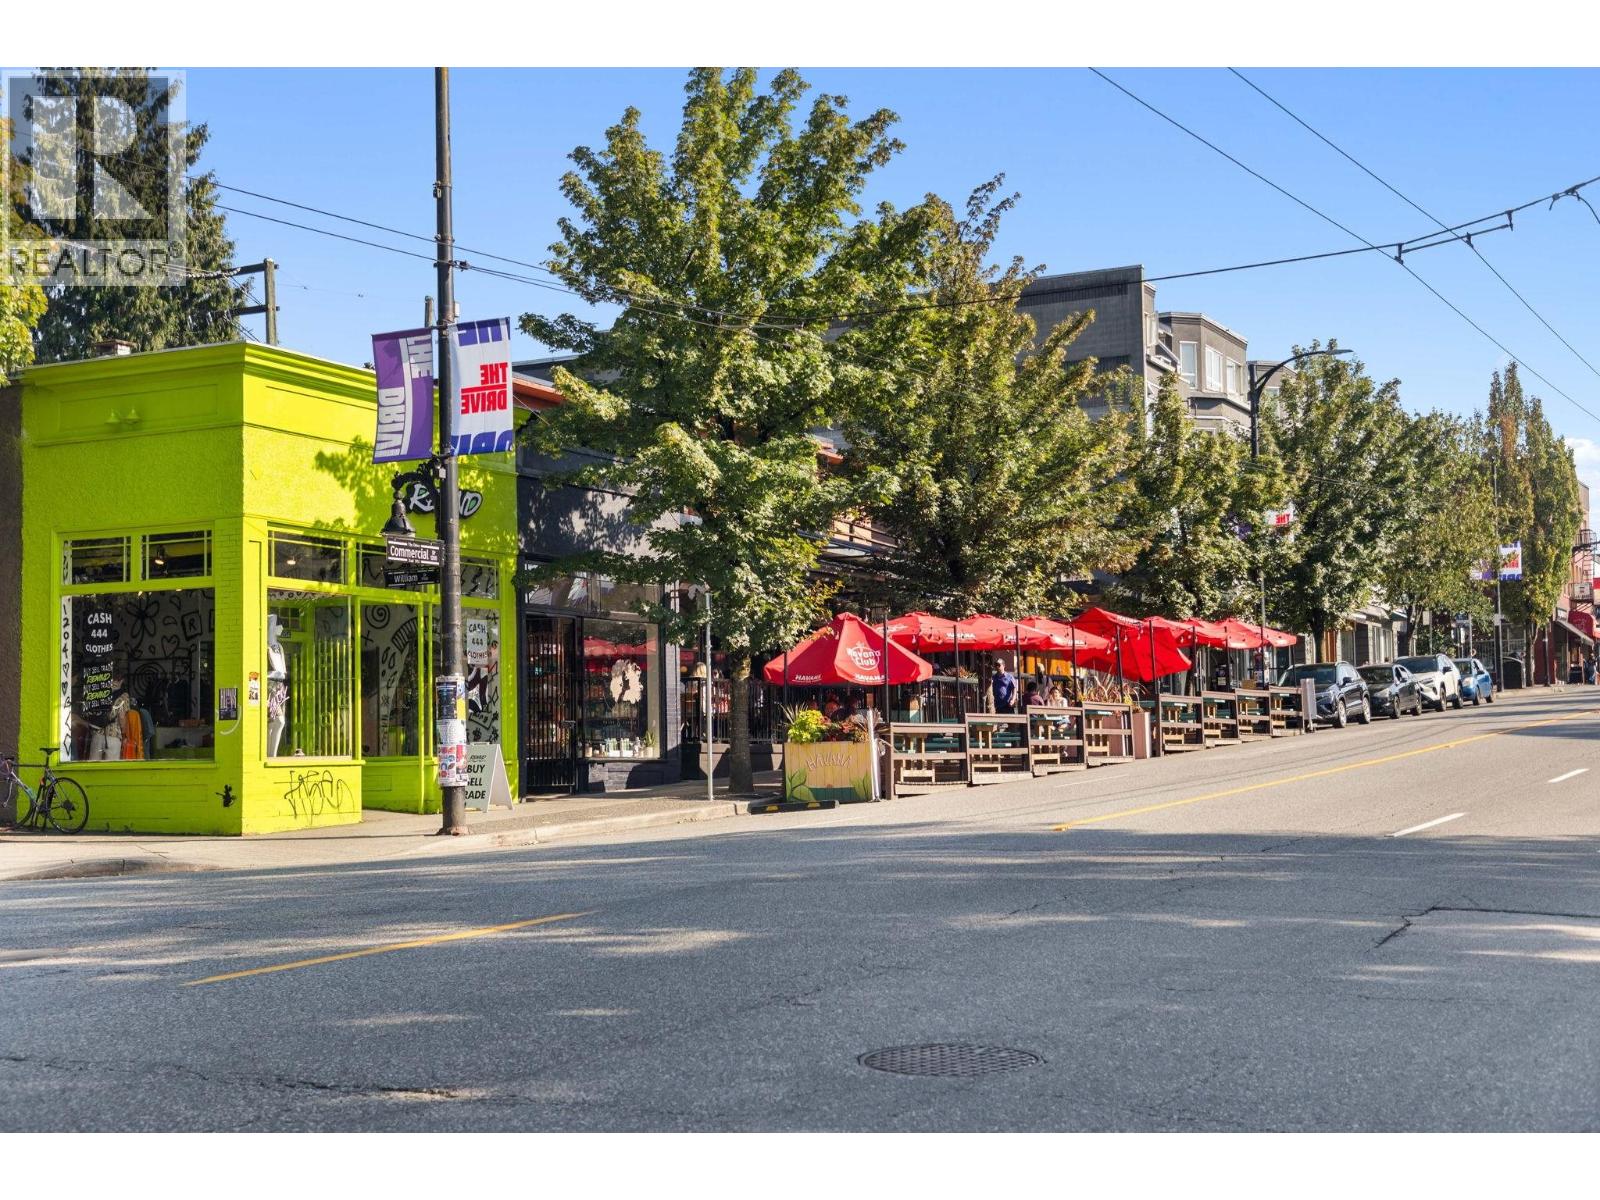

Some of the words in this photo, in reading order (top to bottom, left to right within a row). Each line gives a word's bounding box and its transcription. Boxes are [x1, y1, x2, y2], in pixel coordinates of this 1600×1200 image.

[390, 545, 429, 560] Commercial
[394, 574, 418, 583] William
[87, 612, 112, 625] CASH
[91, 628, 108, 638] 444
[469, 623, 486, 633] CASH
[471, 637, 484, 646] 444
[85, 643, 113, 653] CLOTHES
[847, 648, 881, 658] Havana
[856, 657, 876, 666] Club
[806, 752, 851, 771] HAVANA
[467, 764, 486, 774] BUY
[465, 790, 487, 800] RADE
